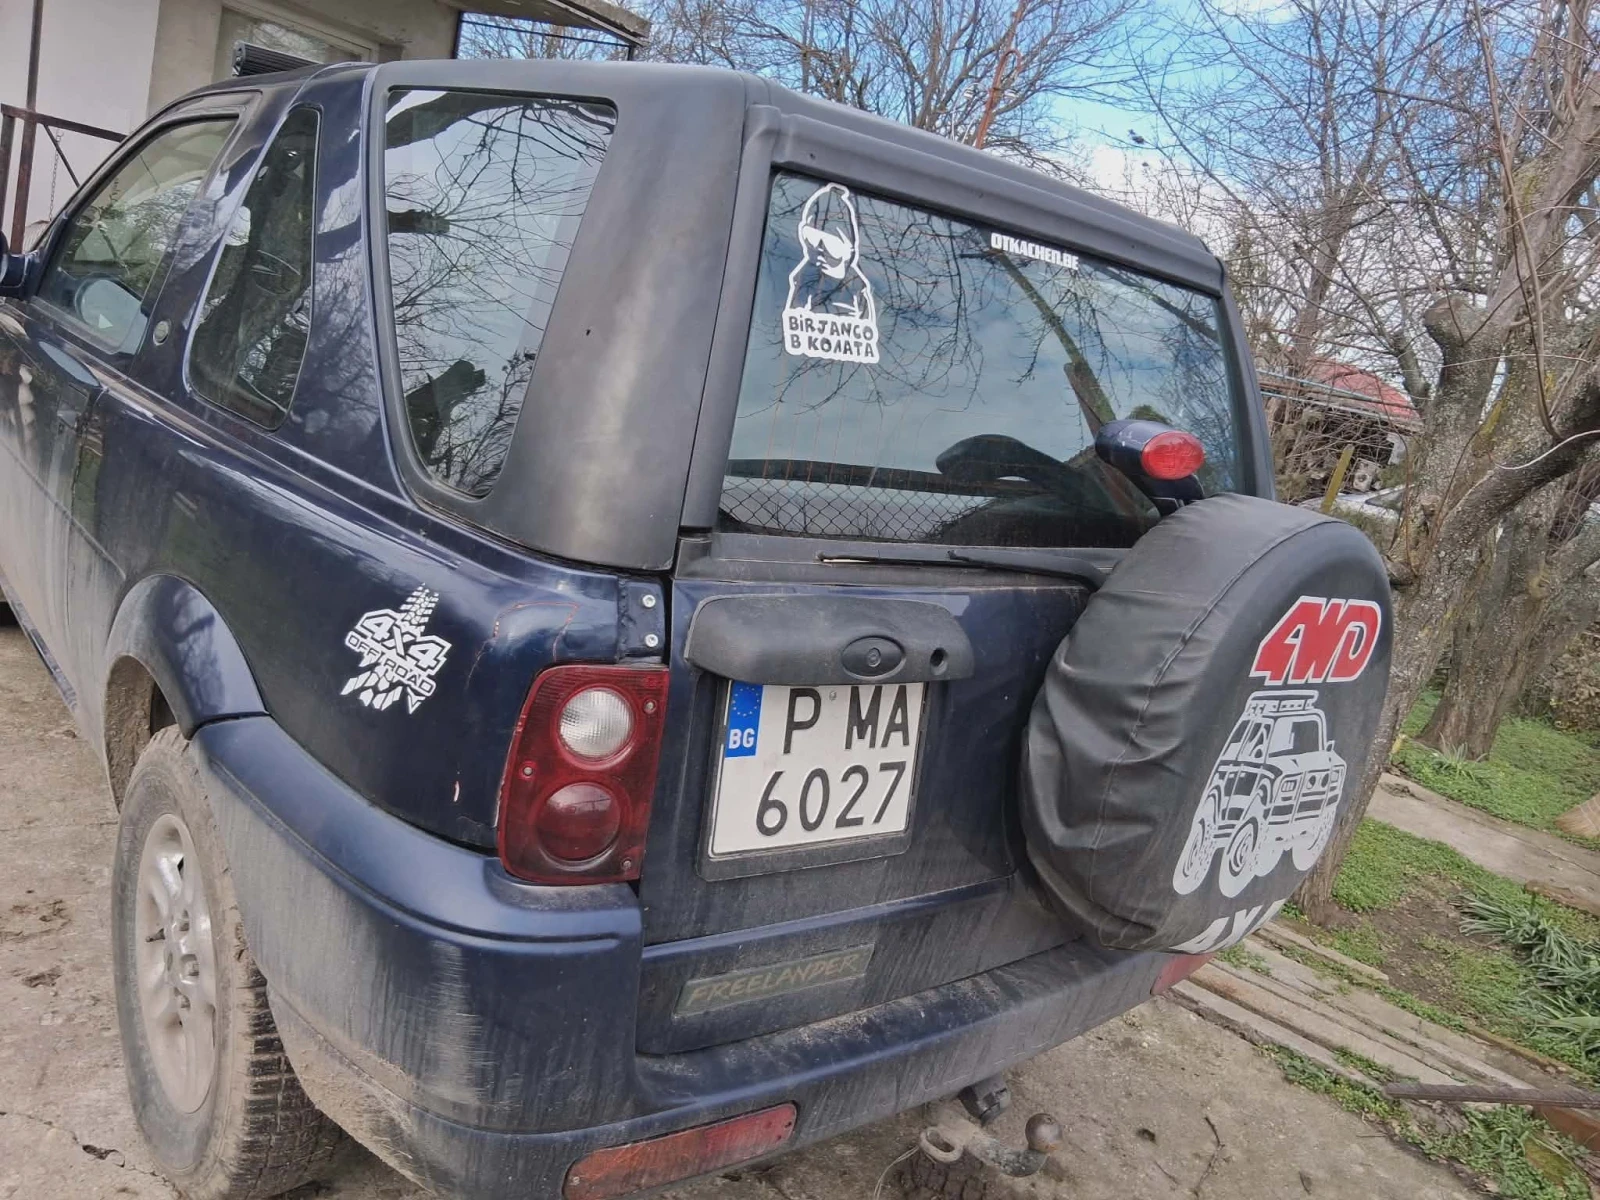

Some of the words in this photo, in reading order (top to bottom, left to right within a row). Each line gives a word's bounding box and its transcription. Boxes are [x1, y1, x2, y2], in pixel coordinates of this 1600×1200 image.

[346, 632, 380, 658] OFF
[383, 657, 435, 694] ROAD
[1249, 596, 1381, 686] 4WD
[728, 728, 755, 749] BG
[782, 687, 822, 754] P
[844, 684, 910, 750] MA
[756, 760, 907, 837] 6027
[686, 953, 861, 1007] FREELANDER
